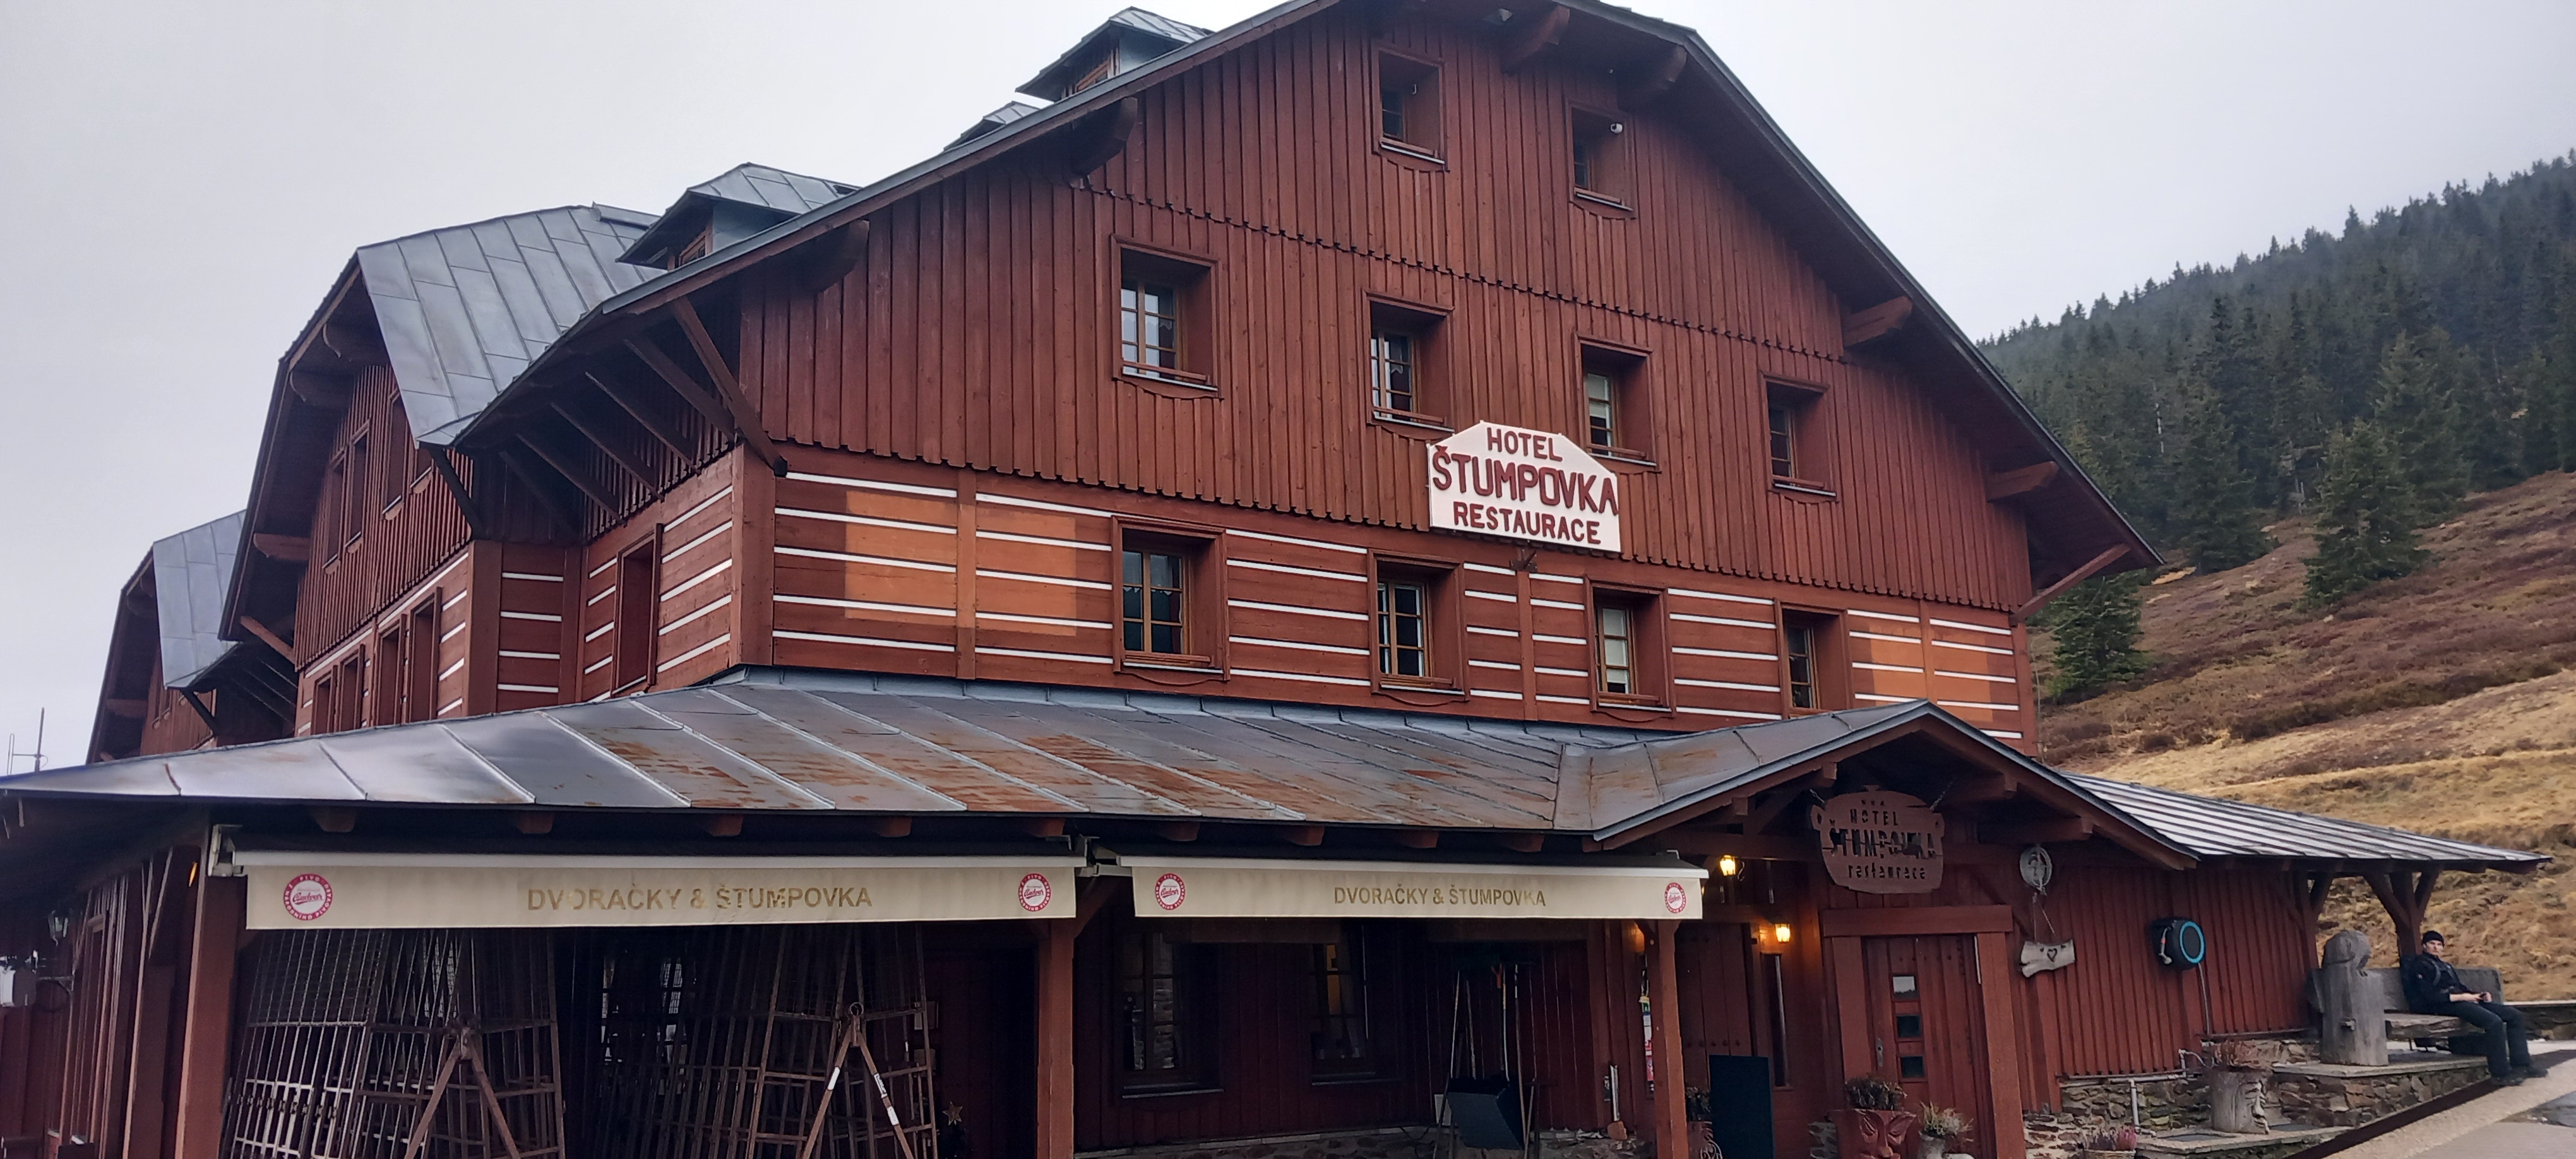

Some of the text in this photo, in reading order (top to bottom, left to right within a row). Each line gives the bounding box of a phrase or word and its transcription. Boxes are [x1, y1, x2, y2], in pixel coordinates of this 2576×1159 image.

[1486, 427, 1563, 462] HOTEL
[1432, 444, 1619, 516] ŠTUMPOVKA
[1453, 501, 1601, 544] RESTAURACE
[1849, 808, 1898, 826] HOTEL
[527, 883, 873, 910] DVORAČKY & ŠTUMPOVKA
[1334, 884, 1546, 906] DVORAČKY & ŠTUMPOVKA
